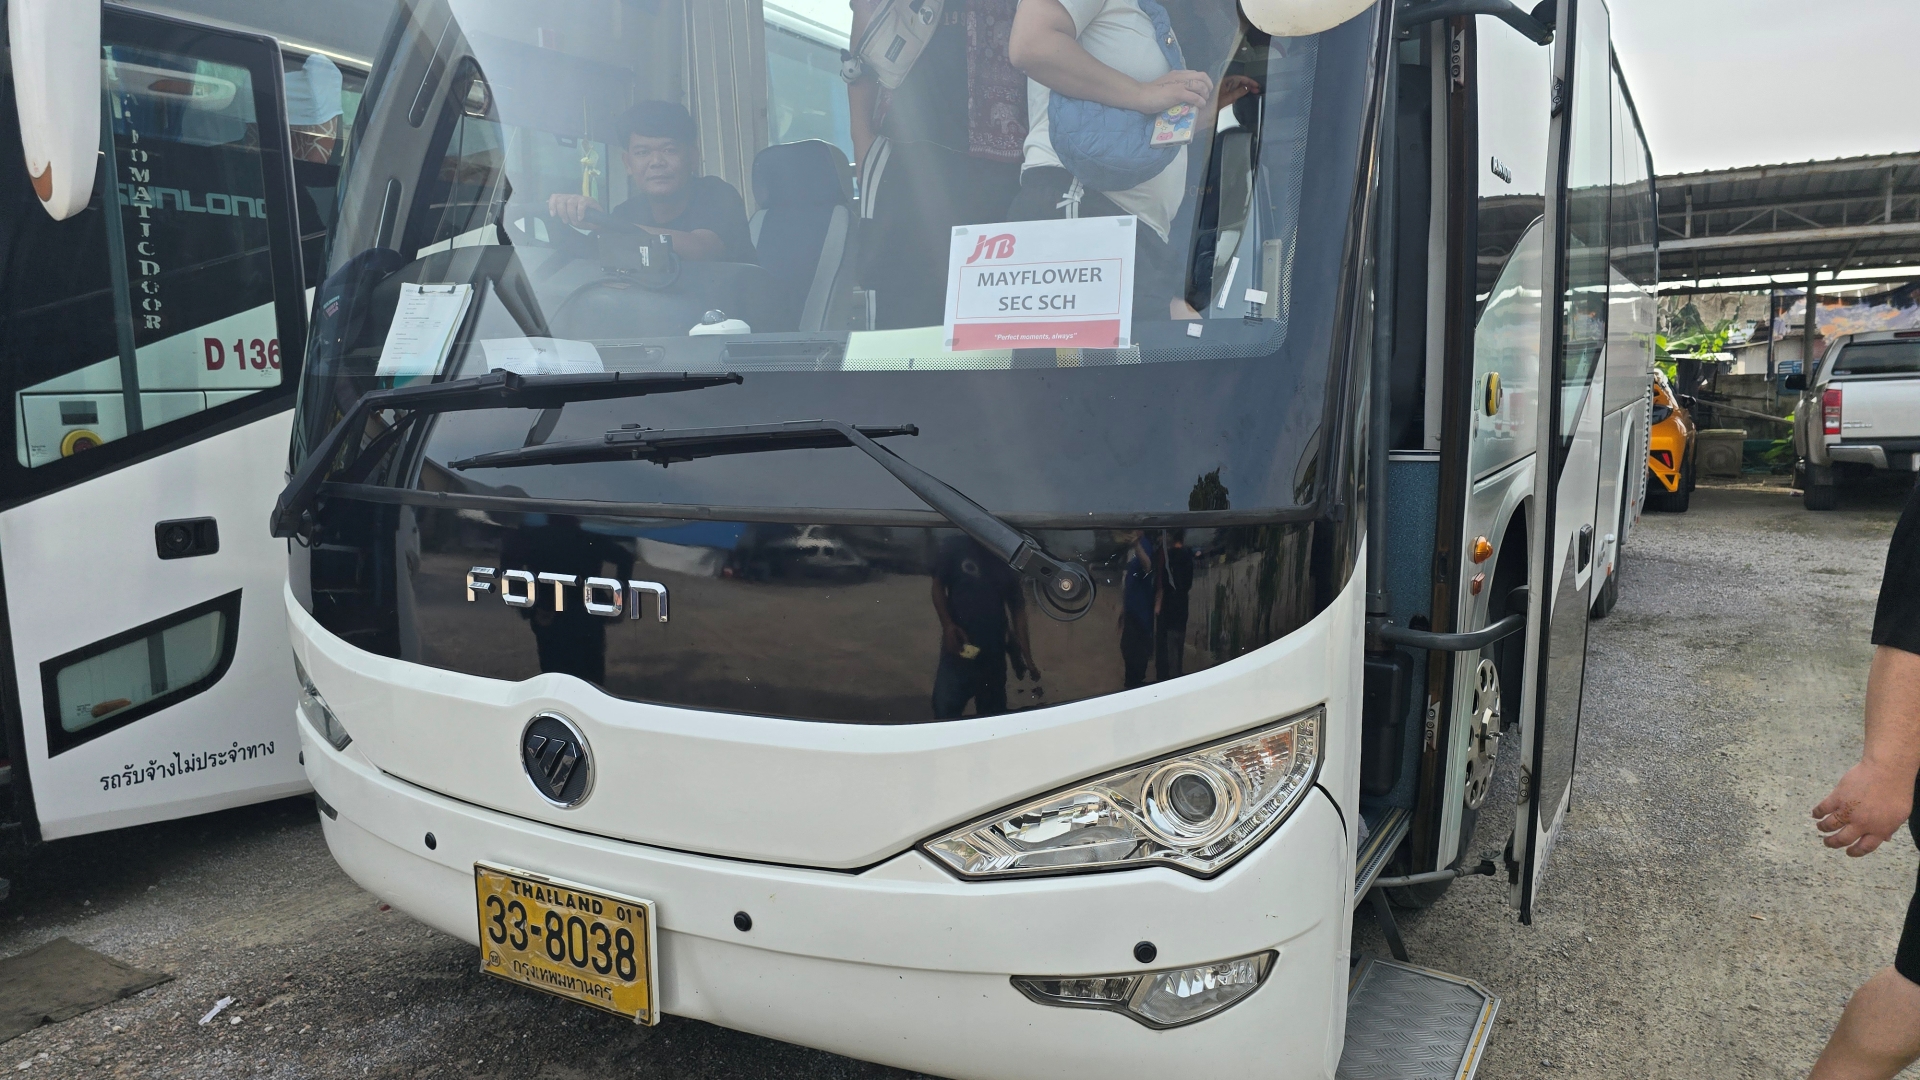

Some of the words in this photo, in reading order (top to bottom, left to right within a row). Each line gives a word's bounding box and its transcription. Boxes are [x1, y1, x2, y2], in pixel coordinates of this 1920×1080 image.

[966, 233, 1016, 264] JTB
[977, 267, 1102, 287] MAYFLOWER
[998, 296, 1033, 311] SEC
[1038, 294, 1076, 311] SCH
[204, 338, 225, 370] D
[466, 566, 668, 622] FOTON
[99, 741, 275, 791] รถรับจ้างไม่ประจำทาง
[511, 880, 603, 915] THAILAND
[616, 906, 632, 923] 01
[486, 895, 637, 982] 33-8038
[514, 960, 612, 1001] กรุงเทพมหานคร
